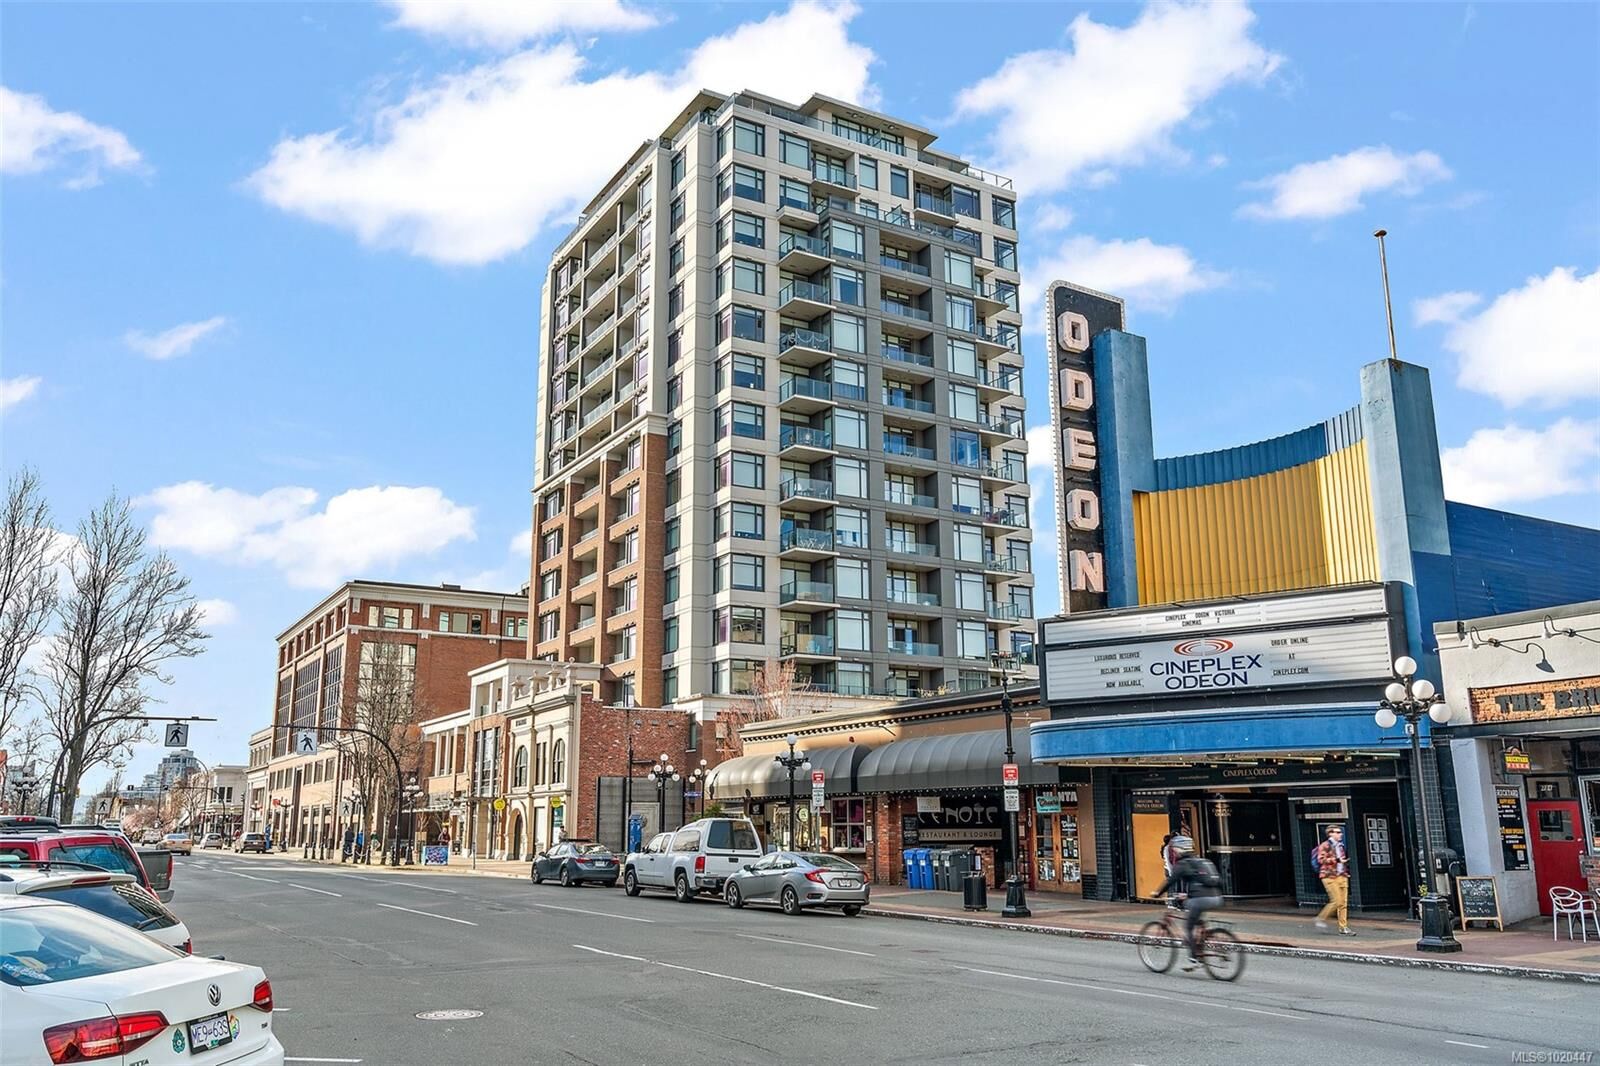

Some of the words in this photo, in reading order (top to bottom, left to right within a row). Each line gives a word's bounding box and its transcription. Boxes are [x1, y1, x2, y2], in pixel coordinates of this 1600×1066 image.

[1057, 311, 1105, 593] ODEON
[1165, 614, 1187, 622] CINEPLEX
[1181, 619, 1202, 627] CINEMAS
[1271, 638, 1288, 646] ORDER
[1149, 654, 1263, 676] CINEPLEX
[1165, 671, 1248, 690] ODEON
[1494, 692, 1546, 714] THE
[1222, 769, 1253, 777] CINEPLEX
[1253, 768, 1278, 776] ODEON
